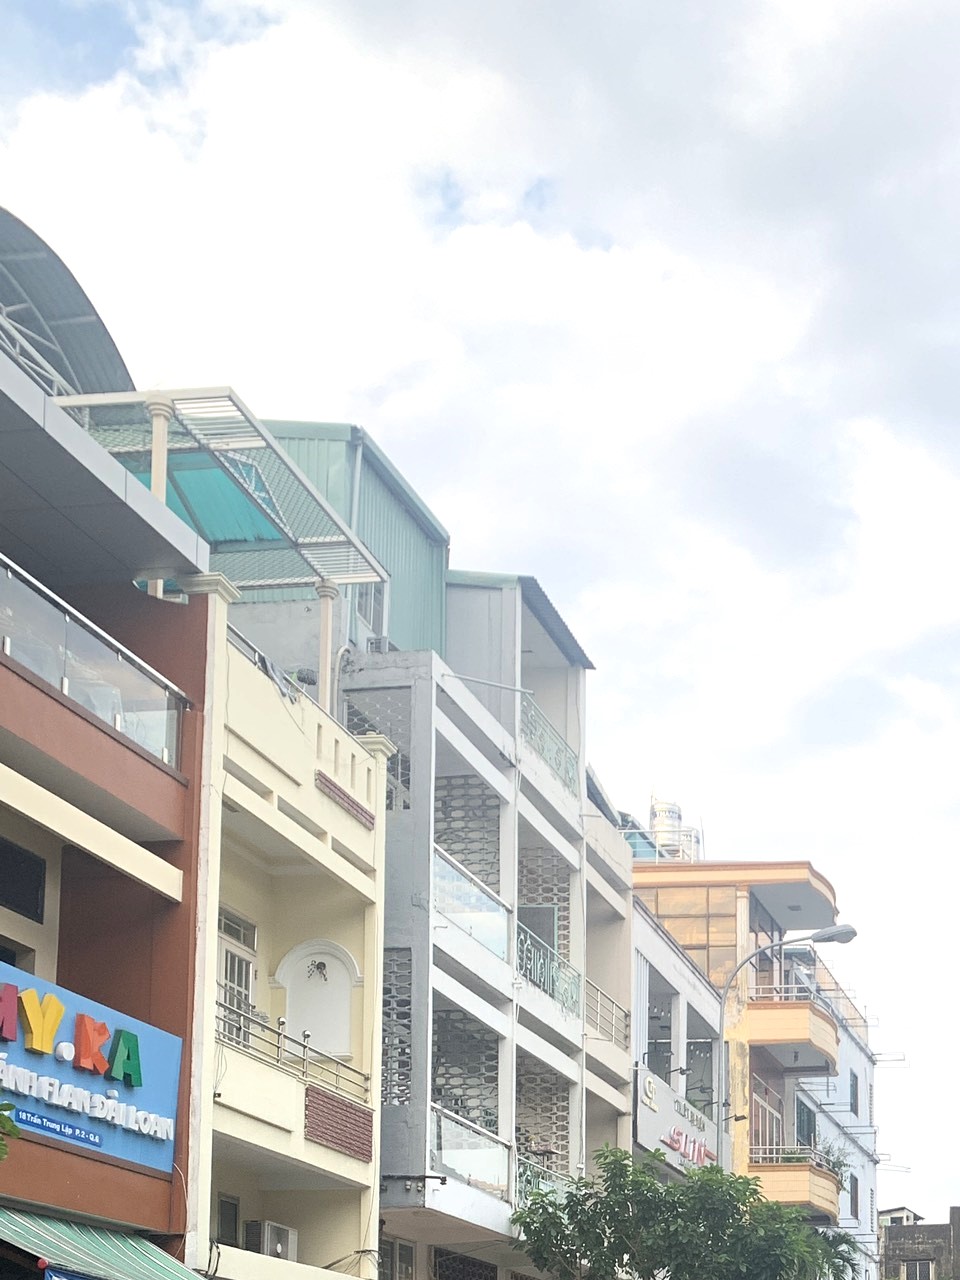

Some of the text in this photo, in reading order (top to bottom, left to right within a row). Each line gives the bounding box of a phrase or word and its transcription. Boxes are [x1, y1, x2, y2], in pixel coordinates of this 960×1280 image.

[37, 1076, 91, 1113] FLAN
[89, 1089, 126, 1126] ĐÀI
[123, 1105, 174, 1140] LOAN
[43, 1118, 60, 1131] Trung
